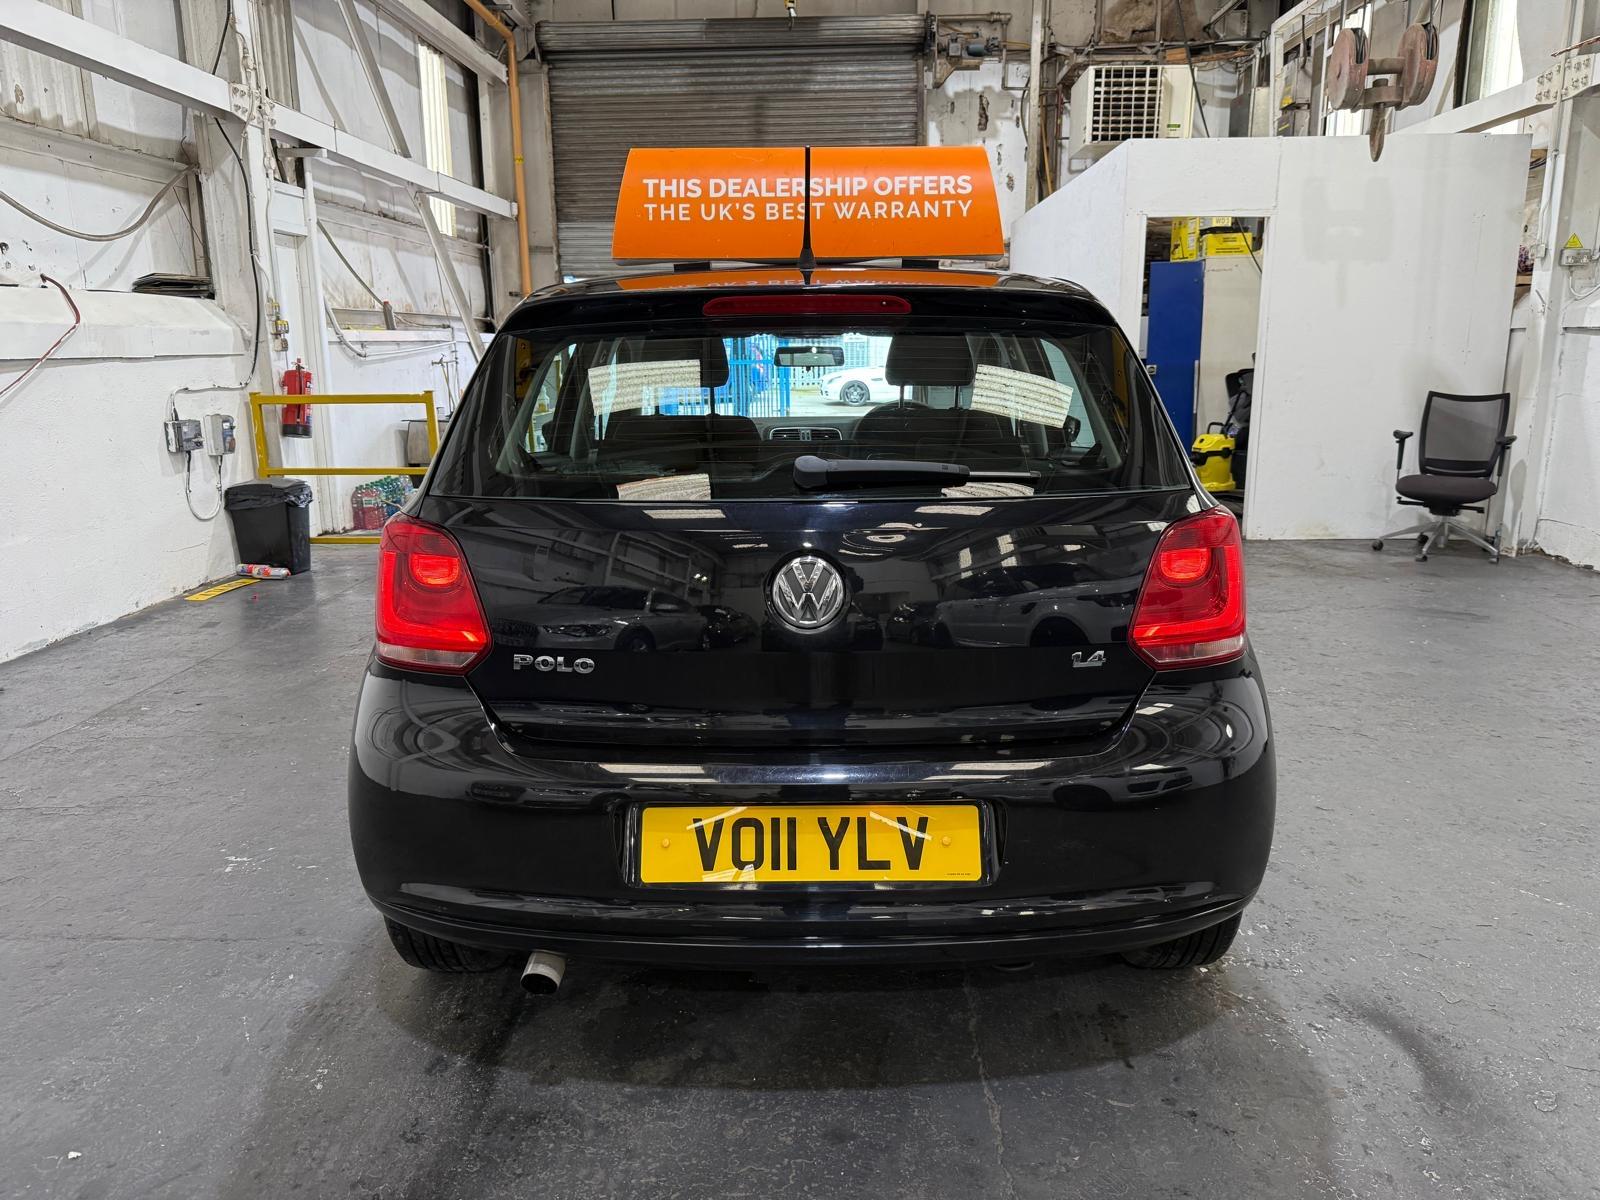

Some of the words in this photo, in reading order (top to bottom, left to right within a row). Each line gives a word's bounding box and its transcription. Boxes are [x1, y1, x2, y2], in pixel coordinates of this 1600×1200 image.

[643, 178, 702, 199] THIS
[709, 176, 867, 199] DEALERSHIP
[873, 175, 973, 197] OFFERS
[643, 203, 691, 221] THE
[700, 202, 756, 221] UK'S
[765, 202, 826, 221] BEST
[833, 199, 974, 220] WARRANTY
[513, 654, 595, 674] POLO
[817, 816, 929, 871] YLV
